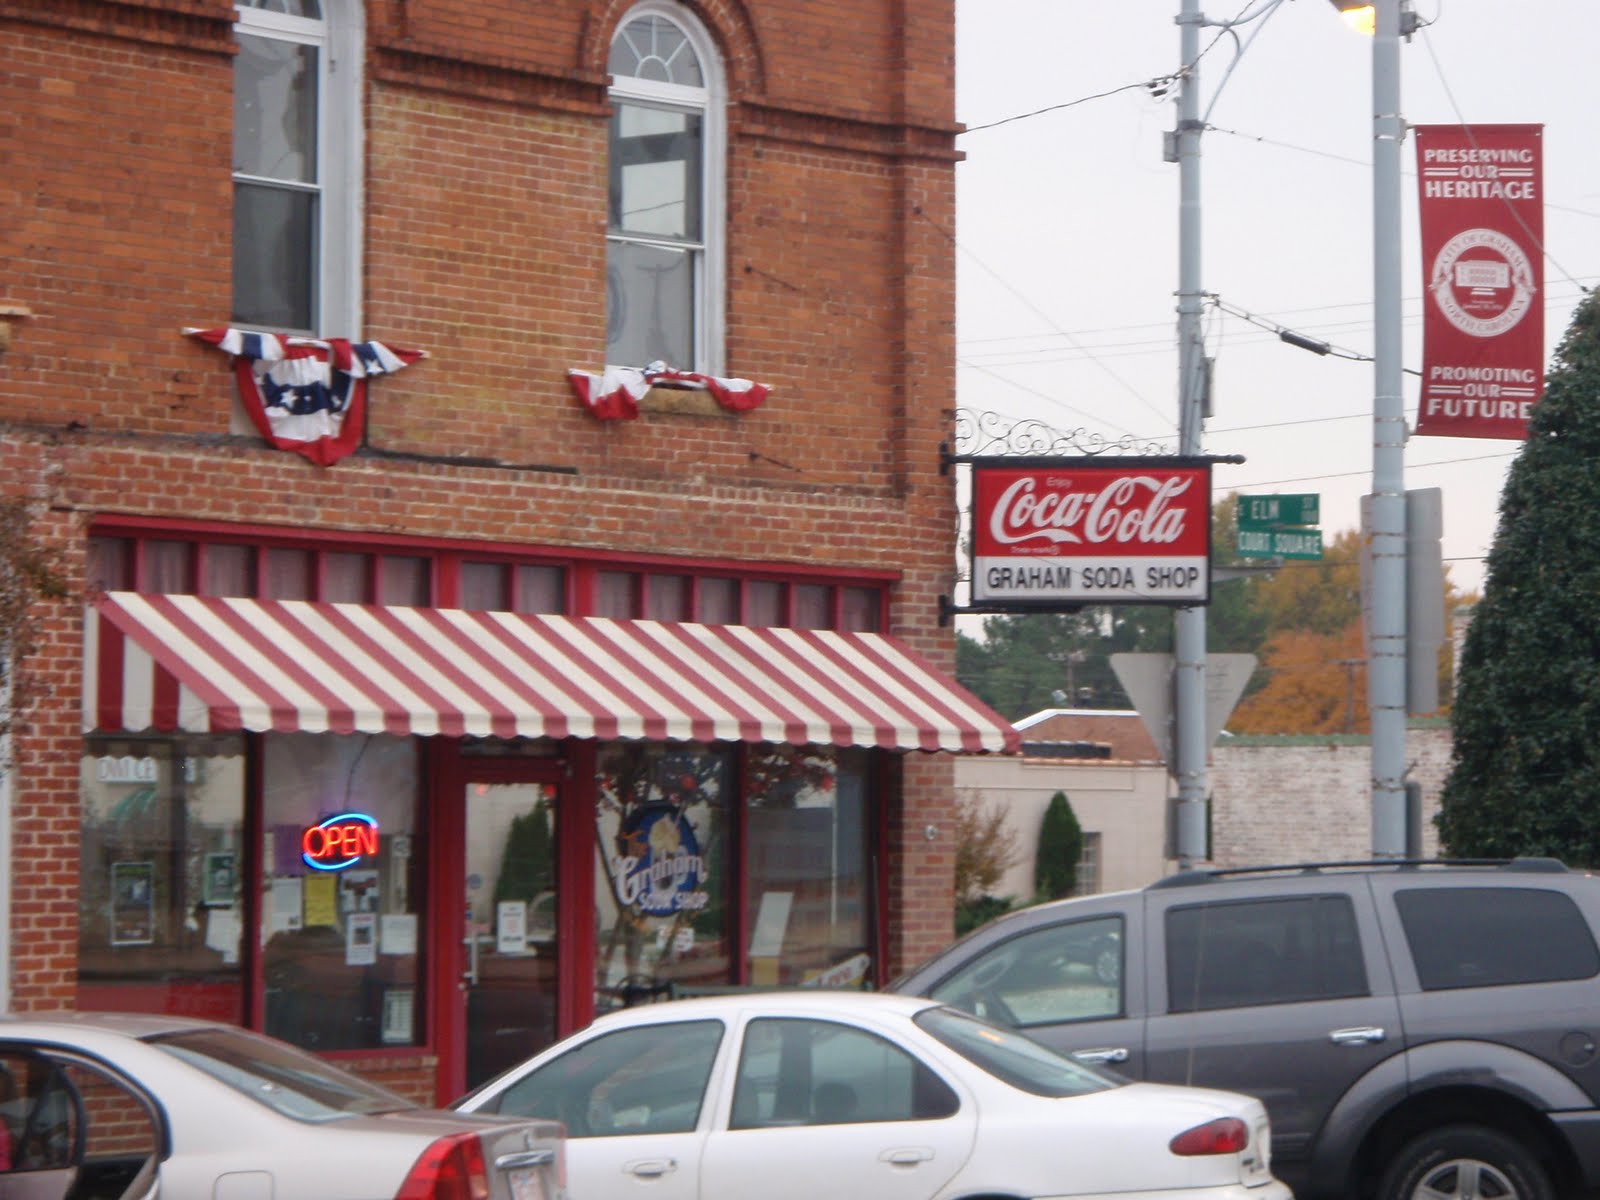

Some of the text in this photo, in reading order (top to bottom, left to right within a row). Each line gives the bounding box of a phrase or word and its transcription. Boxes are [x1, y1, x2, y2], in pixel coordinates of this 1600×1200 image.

[1424, 149, 1533, 162] PRESERVING
[1460, 165, 1499, 179] OUR
[1425, 181, 1536, 199] HERITAGE
[1431, 366, 1536, 383] PROMOTING
[1463, 383, 1500, 398] OUR
[1426, 398, 1533, 419] FUTURE
[990, 476, 1194, 543] Coca-Cola
[1252, 500, 1279, 519] ELM
[987, 567, 1198, 589] GRAHAM SODA SHOP
[303, 826, 379, 857] OPEN
[613, 850, 709, 905] Graham
